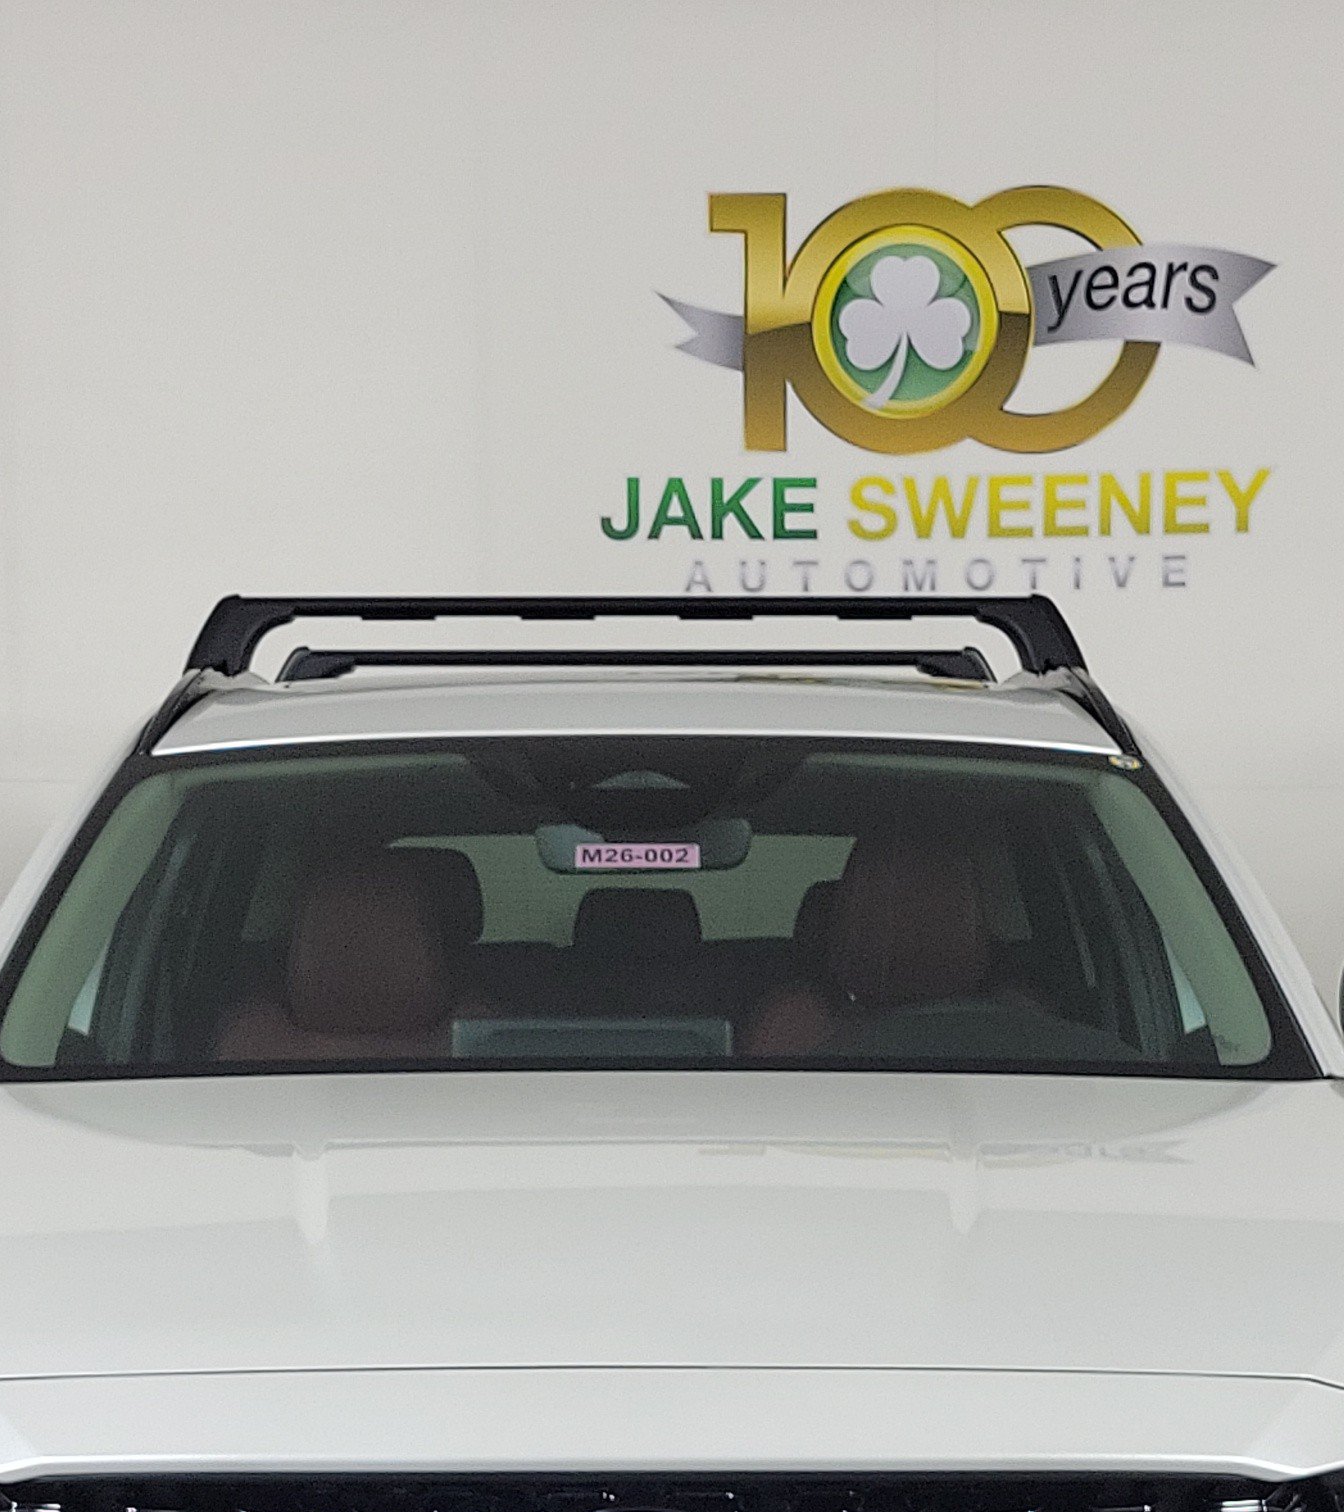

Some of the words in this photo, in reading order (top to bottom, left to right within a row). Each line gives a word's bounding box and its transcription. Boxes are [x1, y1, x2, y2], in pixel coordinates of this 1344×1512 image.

[708, 185, 1161, 454] 100
[1047, 261, 1219, 333] years
[600, 476, 818, 541] JAKE
[846, 469, 1272, 541] SWEENEY
[685, 554, 1189, 594] AUTOMOTIVE
[582, 847, 689, 863] M26-002
